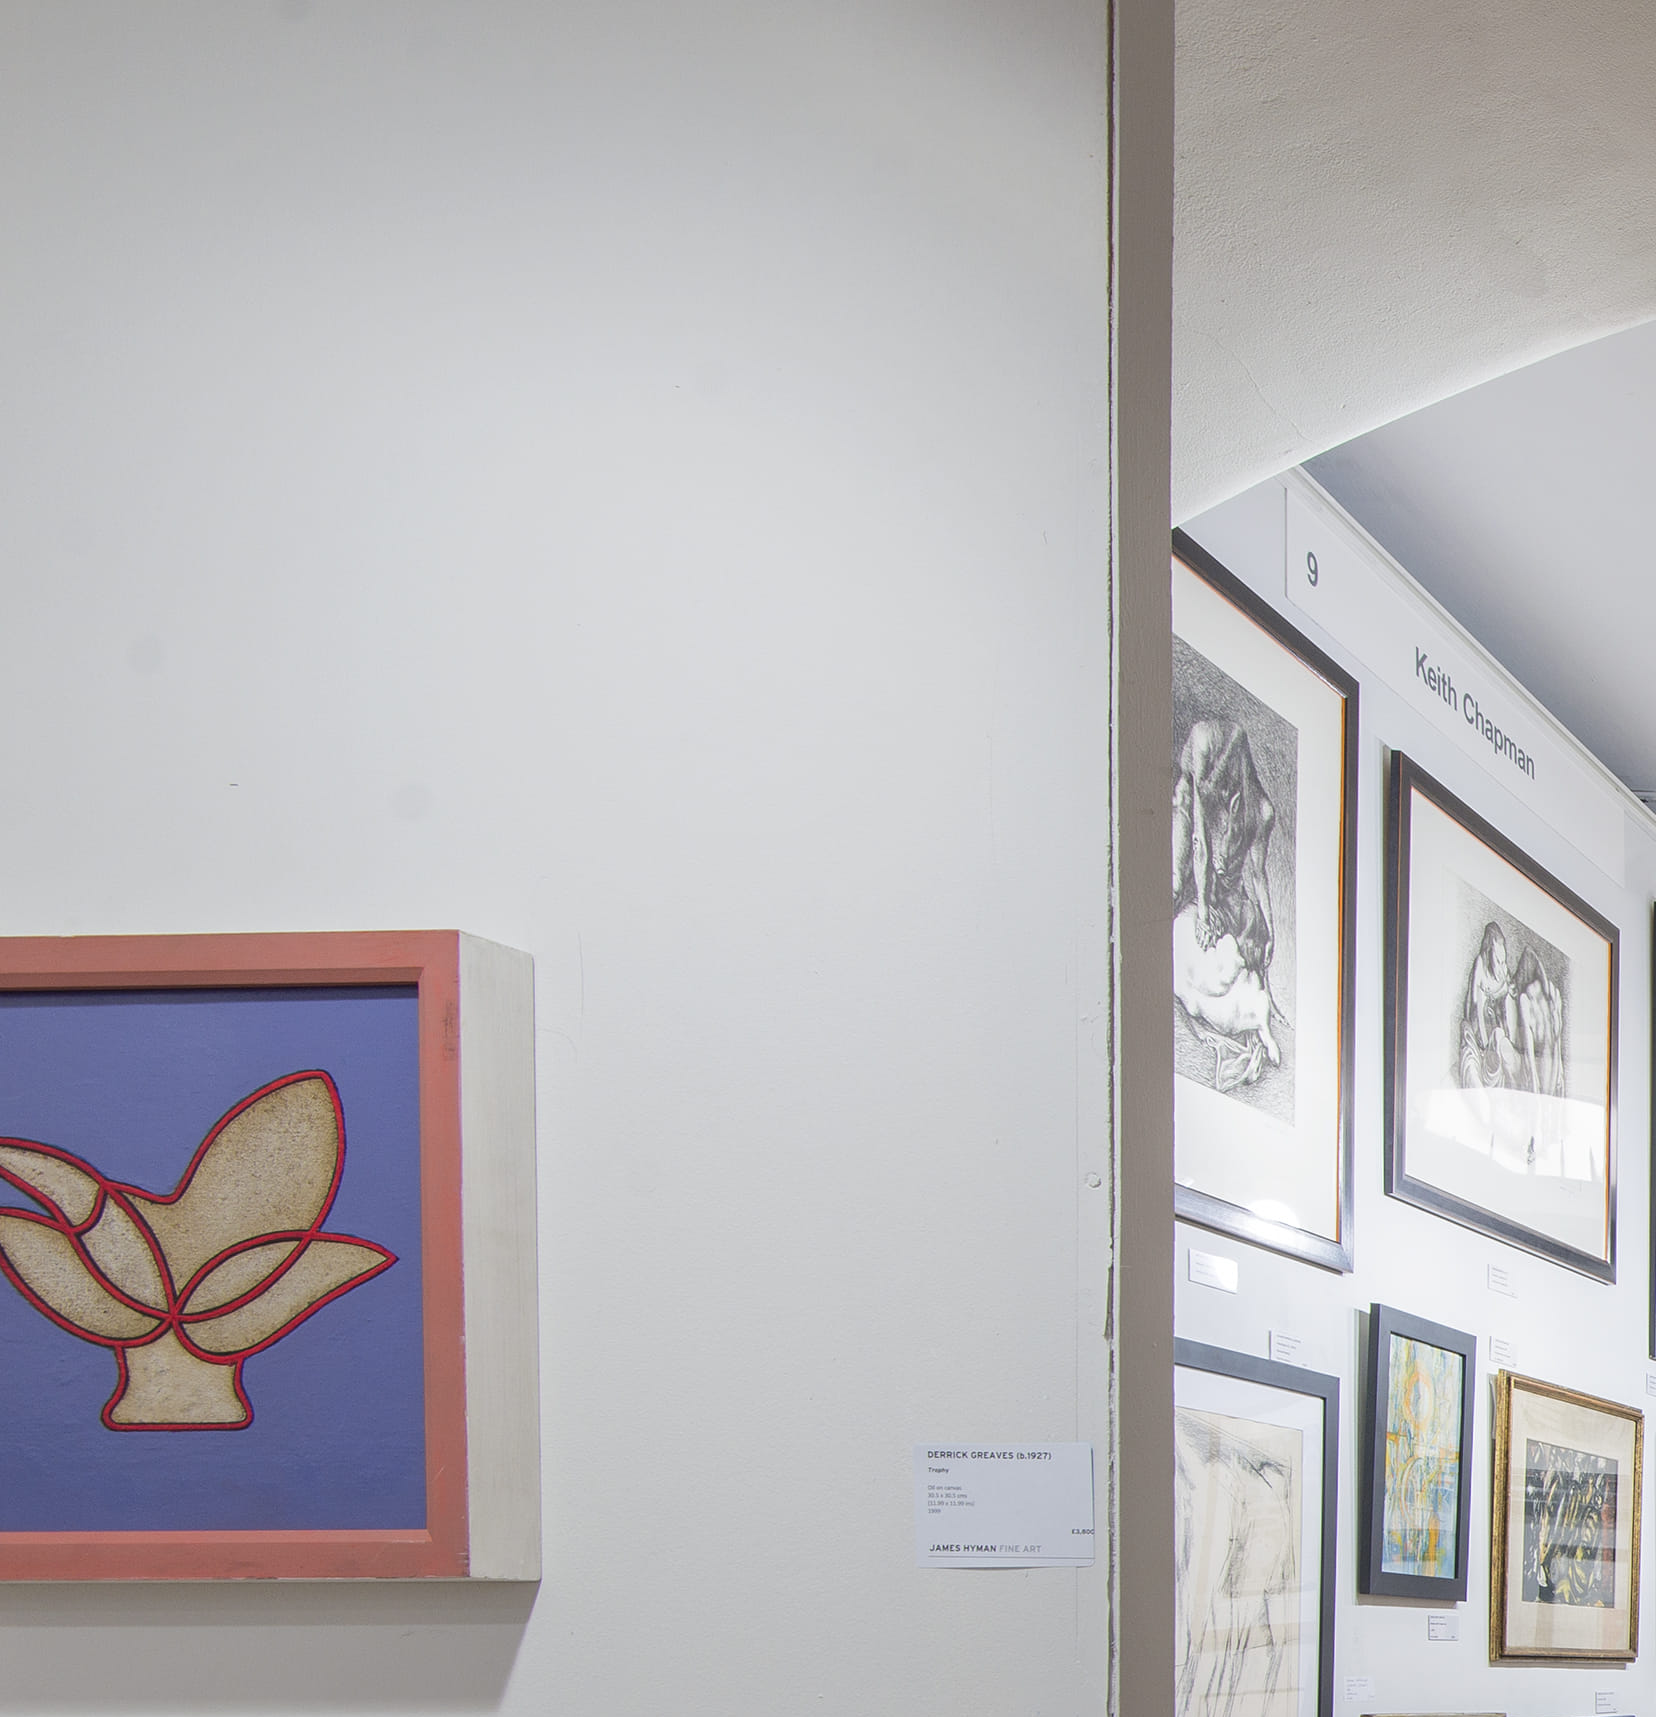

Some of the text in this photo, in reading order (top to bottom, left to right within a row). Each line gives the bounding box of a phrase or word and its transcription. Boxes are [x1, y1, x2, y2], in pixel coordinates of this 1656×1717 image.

[1306, 551, 1319, 588] 9
[1414, 646, 1536, 780] Keith Chapman
[927, 1450, 1052, 1461] DERRICK GREAVES (b.1927)
[929, 1544, 1042, 1553] JAMES HYMAN FINE ART
